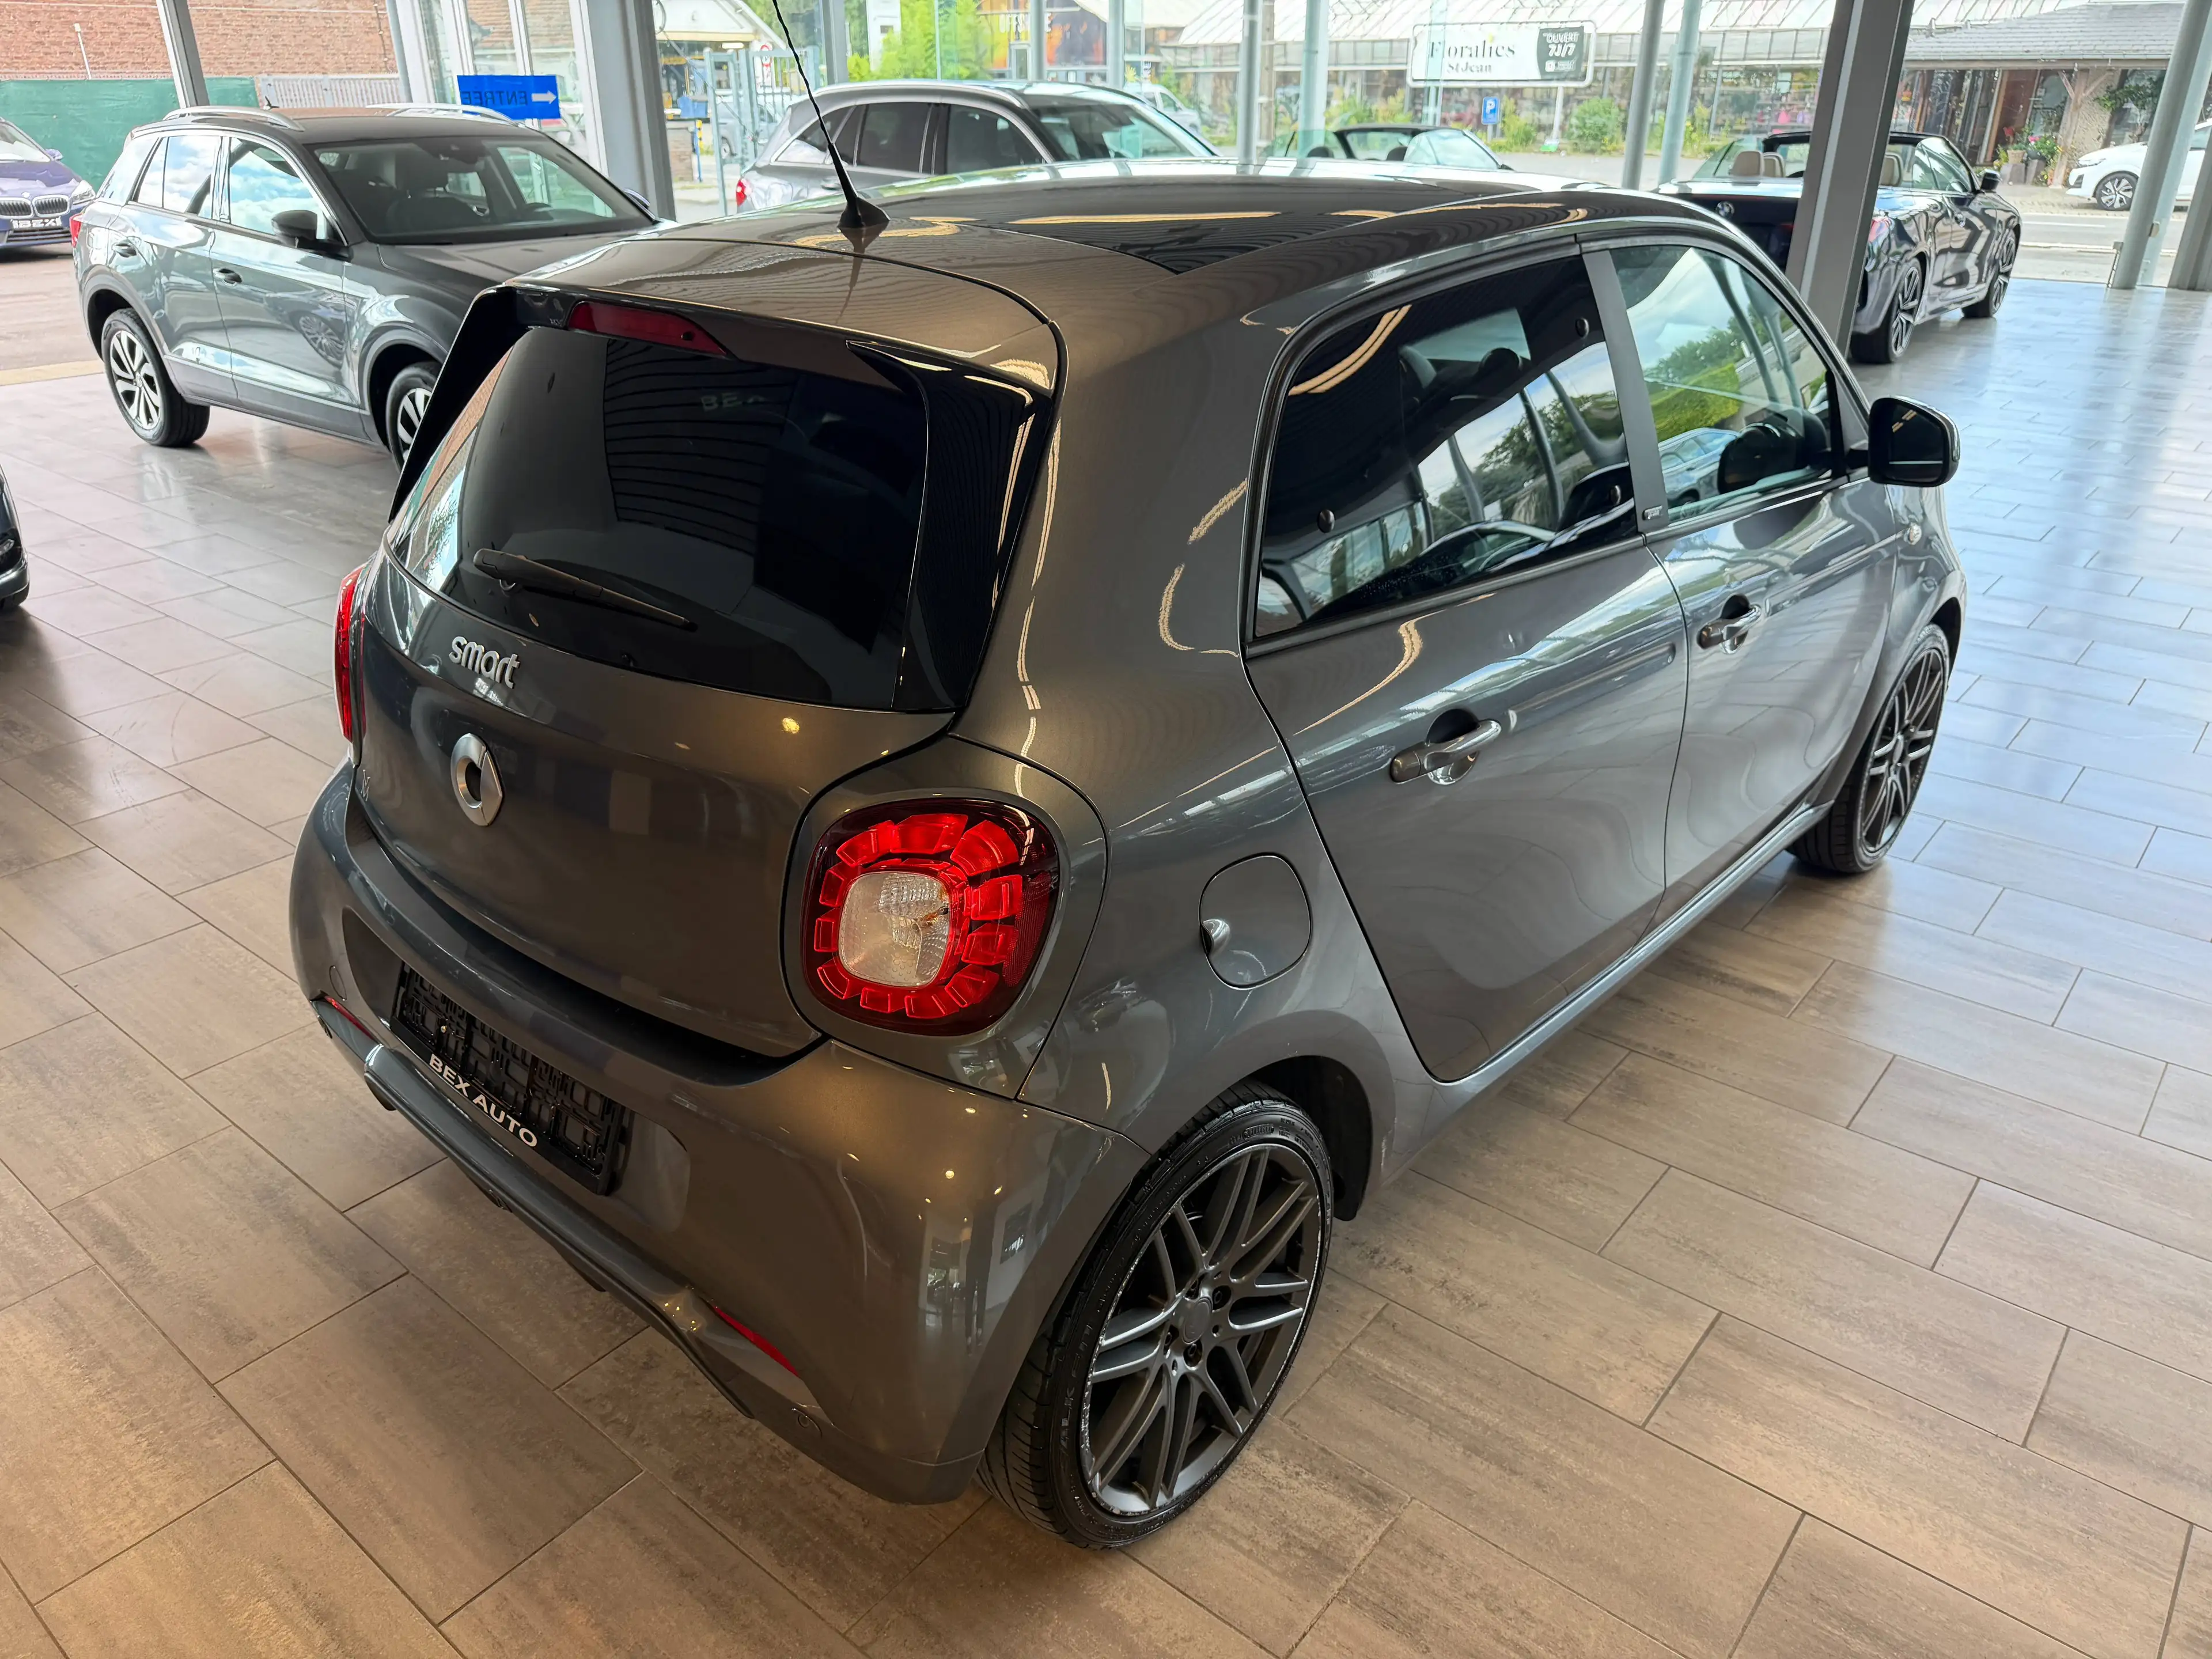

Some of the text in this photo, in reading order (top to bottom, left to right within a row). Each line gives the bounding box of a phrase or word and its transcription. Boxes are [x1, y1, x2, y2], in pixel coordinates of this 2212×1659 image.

[1486, 100, 1496, 115] P
[448, 636, 520, 689] smart
[429, 1054, 537, 1147] BEX AUTO
